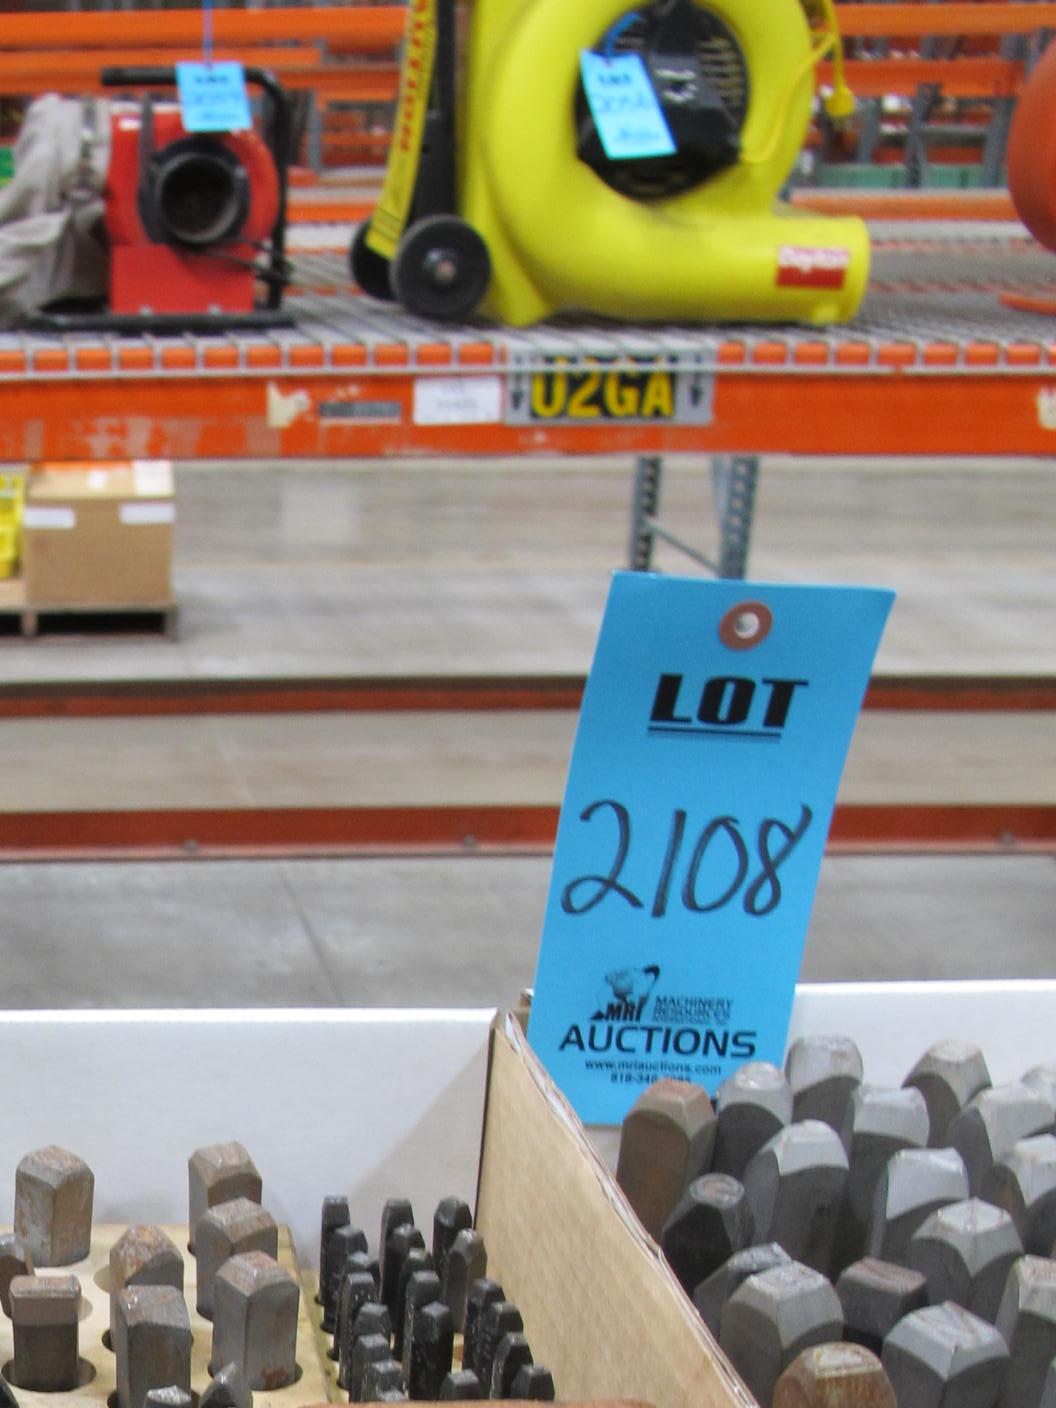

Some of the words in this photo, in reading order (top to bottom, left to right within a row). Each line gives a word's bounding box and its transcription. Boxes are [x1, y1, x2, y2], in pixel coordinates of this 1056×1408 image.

[649, 673, 809, 728] LOT
[560, 799, 813, 918] 2108
[559, 1023, 758, 1059] AUCTIONS
[584, 1059, 722, 1076] www.mriauctions.com
